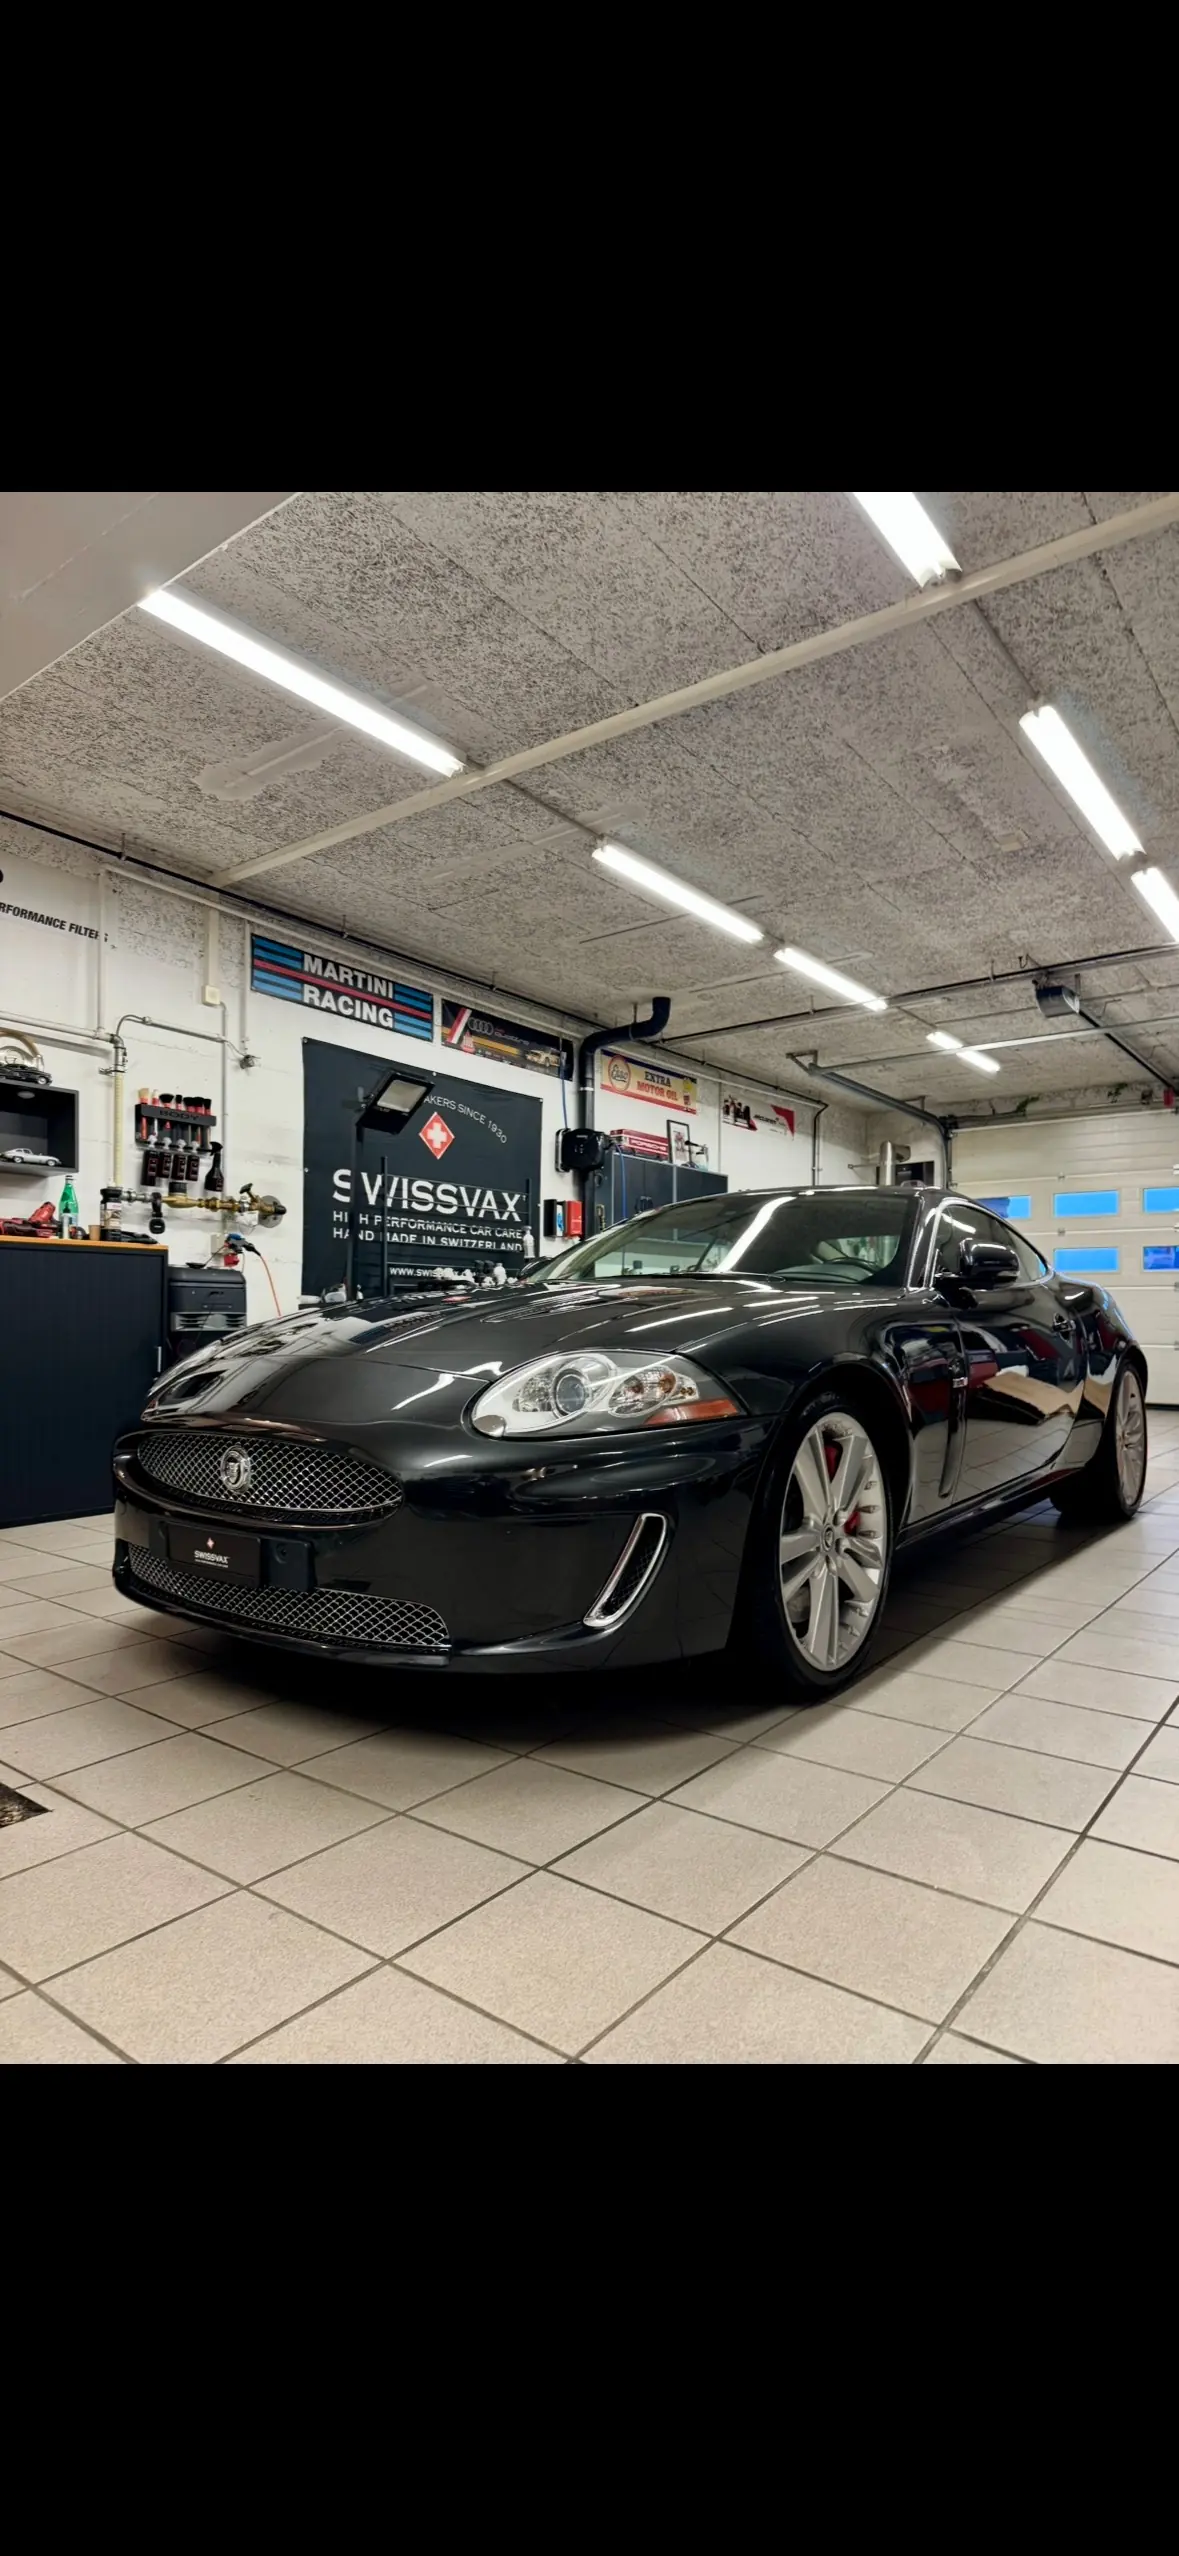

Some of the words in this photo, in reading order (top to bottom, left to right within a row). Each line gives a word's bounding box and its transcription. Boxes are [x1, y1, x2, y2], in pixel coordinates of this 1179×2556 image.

[303, 953, 393, 999] MARTINI
[303, 984, 393, 1028] RACING
[636, 1081, 666, 1097] MOTOR
[666, 1091, 678, 1101] OIL
[644, 1071, 671, 1087] EXTRA
[457, 1103, 486, 1125] SINCE
[487, 1120, 507, 1144] 1930
[332, 1168, 522, 1222] SWISSVAX
[333, 1210, 369, 1225] HIH
[374, 1214, 467, 1234] PERFORMANCE
[469, 1224, 492, 1236] CAR
[495, 1227, 523, 1239] CARE
[422, 1235, 436, 1245] IN
[440, 1238, 523, 1251] SWITZERLAND
[194, 1550, 229, 1564] SWISSVAX
